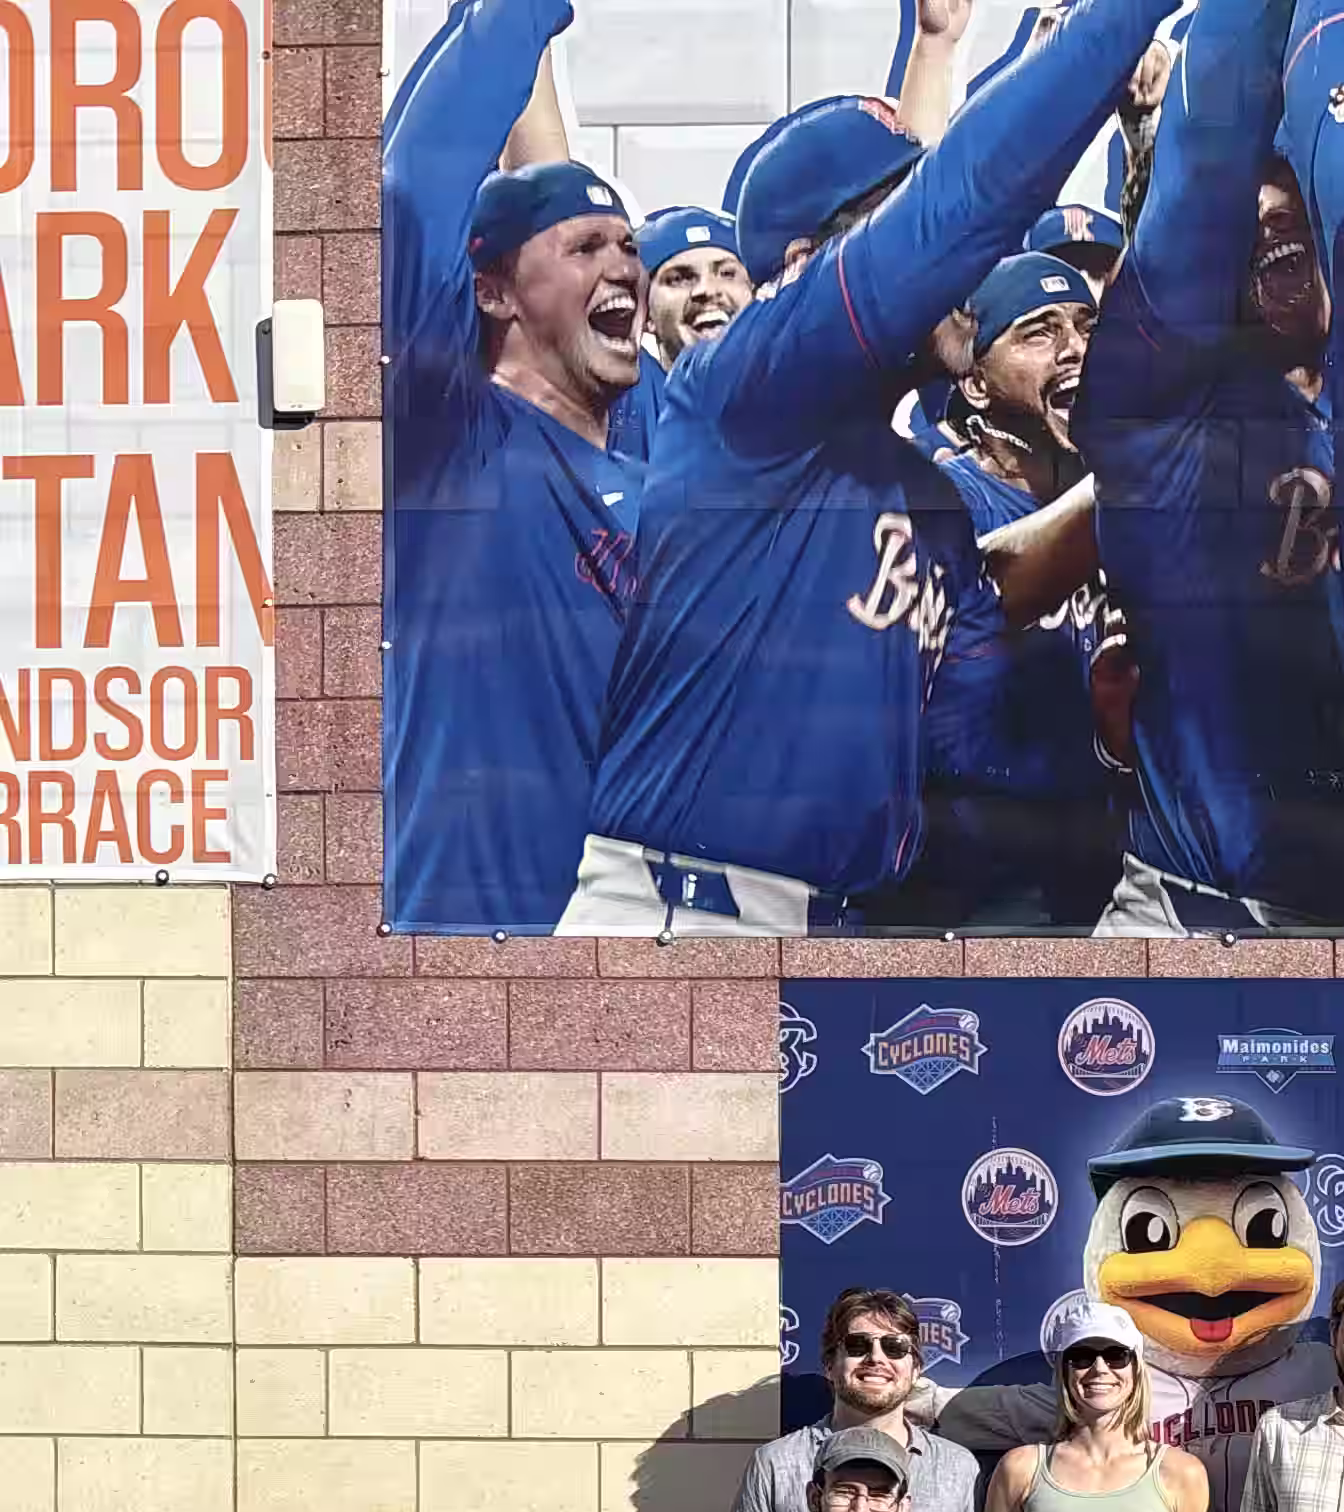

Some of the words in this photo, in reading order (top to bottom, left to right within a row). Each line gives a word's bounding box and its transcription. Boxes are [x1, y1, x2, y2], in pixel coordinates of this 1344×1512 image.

[878, 1033, 971, 1067] CYCLONES
[1076, 1034, 1137, 1066] Mets
[1223, 1039, 1330, 1054] Maimonides
[782, 1182, 875, 1216] CYCLONES
[980, 1184, 1040, 1216] Mets
